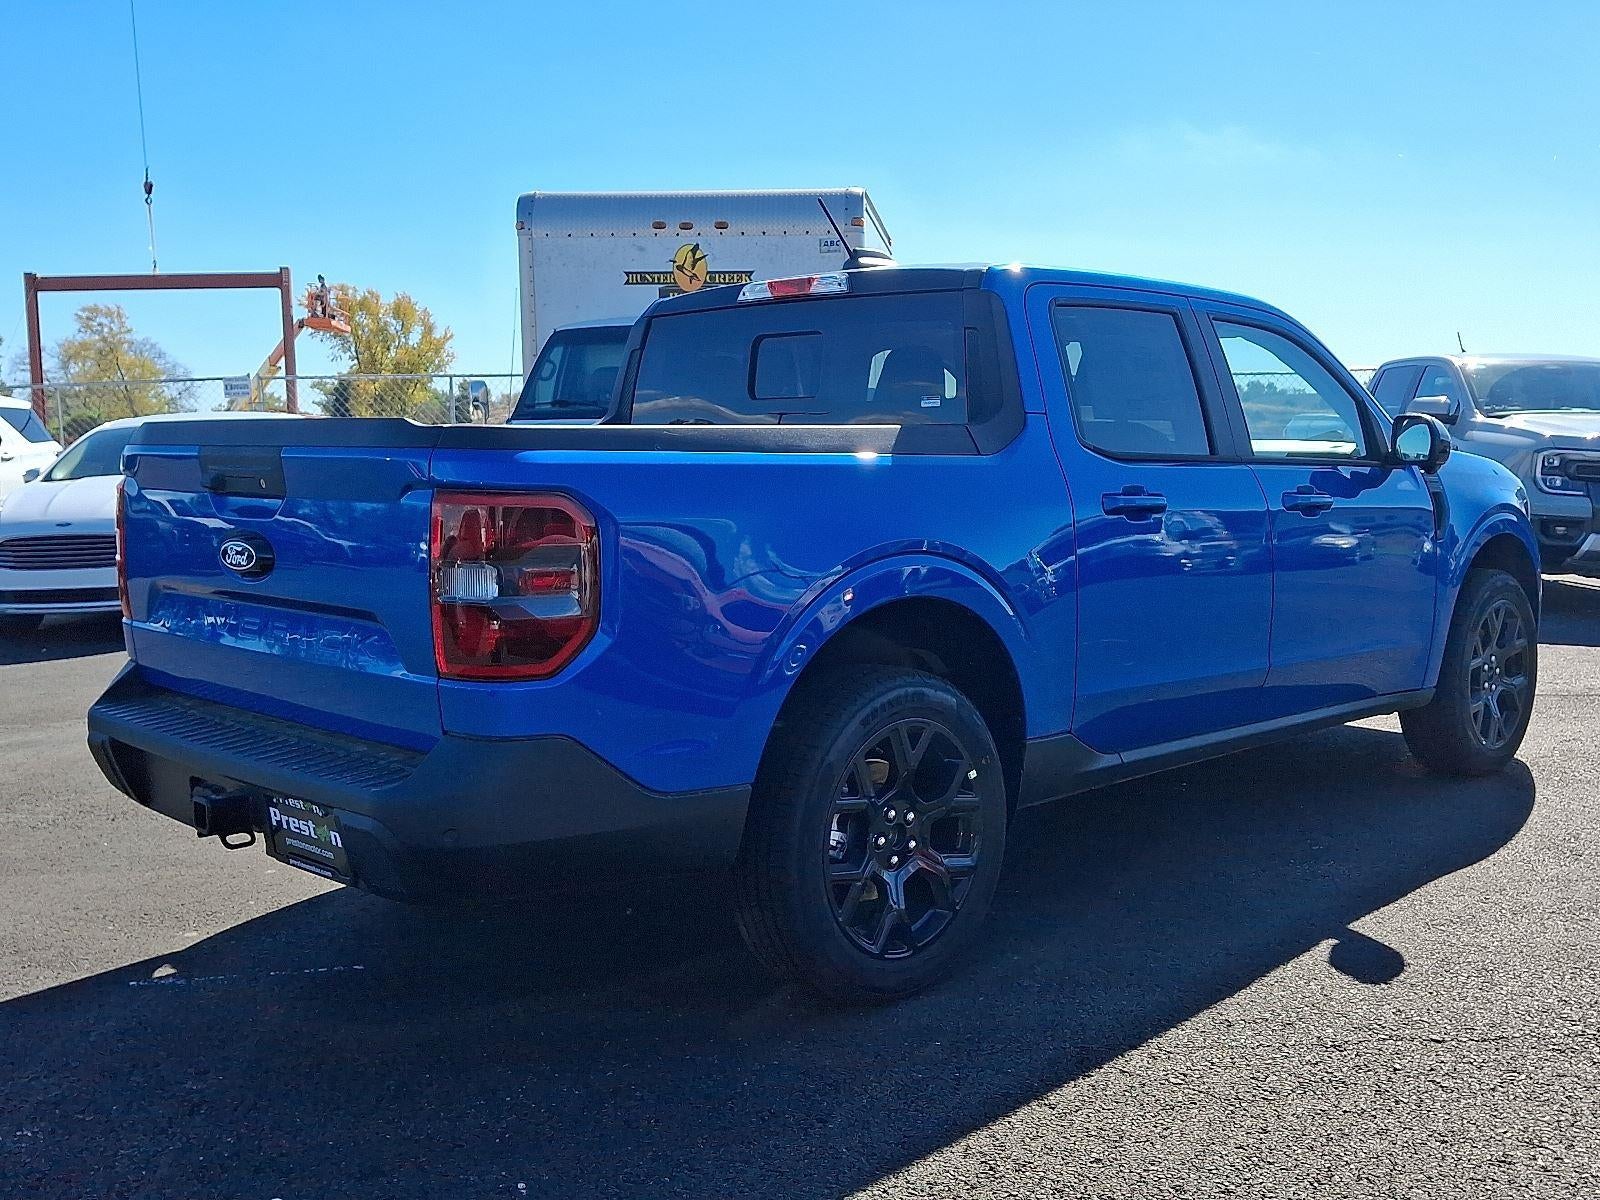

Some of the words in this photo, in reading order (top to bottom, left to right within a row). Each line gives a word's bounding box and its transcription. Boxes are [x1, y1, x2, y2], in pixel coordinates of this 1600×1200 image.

[629, 273, 675, 284] HUNTER
[707, 273, 750, 284] CREEK
[225, 544, 249, 566] Ford
[269, 806, 342, 848] Preston
